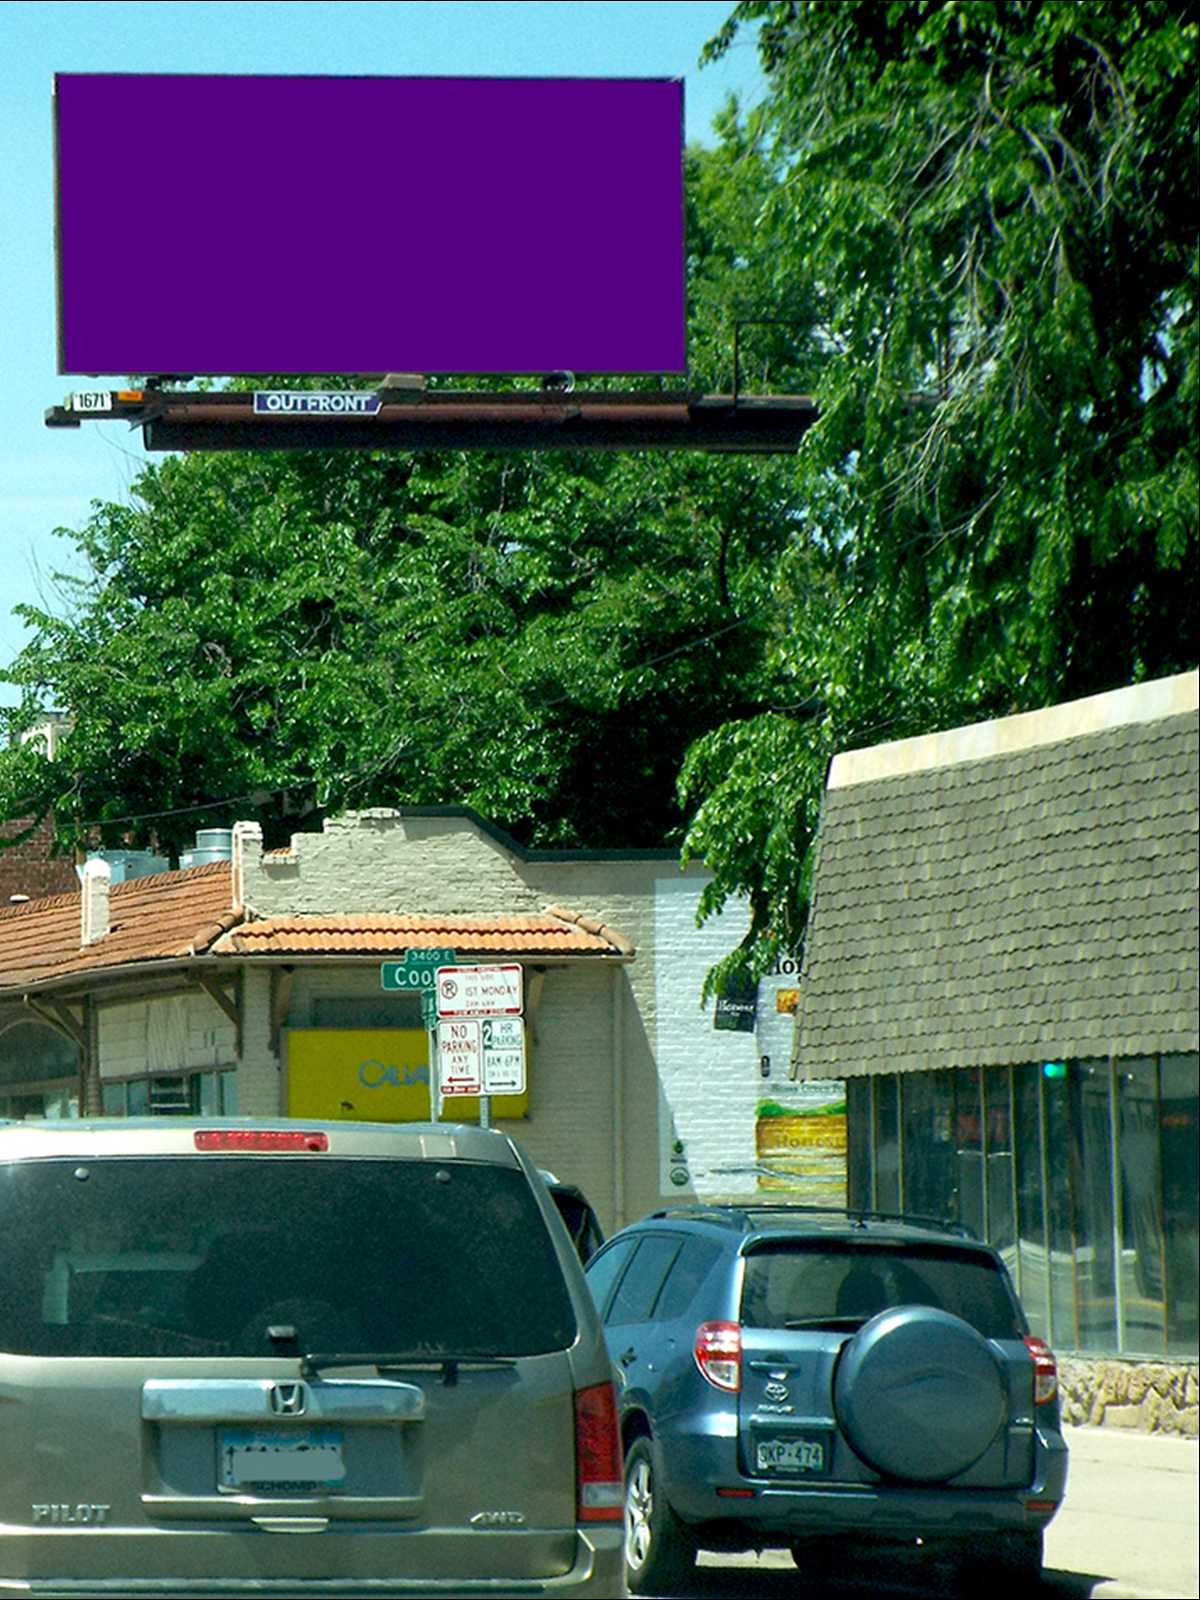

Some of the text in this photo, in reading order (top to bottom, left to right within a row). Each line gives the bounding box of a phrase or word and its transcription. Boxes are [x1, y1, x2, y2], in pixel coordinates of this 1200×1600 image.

[79, 392, 105, 408] 1671
[266, 394, 372, 411] OUTFRONT
[411, 951, 450, 961] 3400 E
[465, 985, 518, 997] 1ST MONDAY
[451, 1024, 467, 1038] NO
[483, 1022, 513, 1046] 2 HR
[441, 1039, 477, 1053] PARKING
[452, 1055, 468, 1064] ANY
[451, 1065, 469, 1075] TIME
[32, 1503, 111, 1522] PILOT
